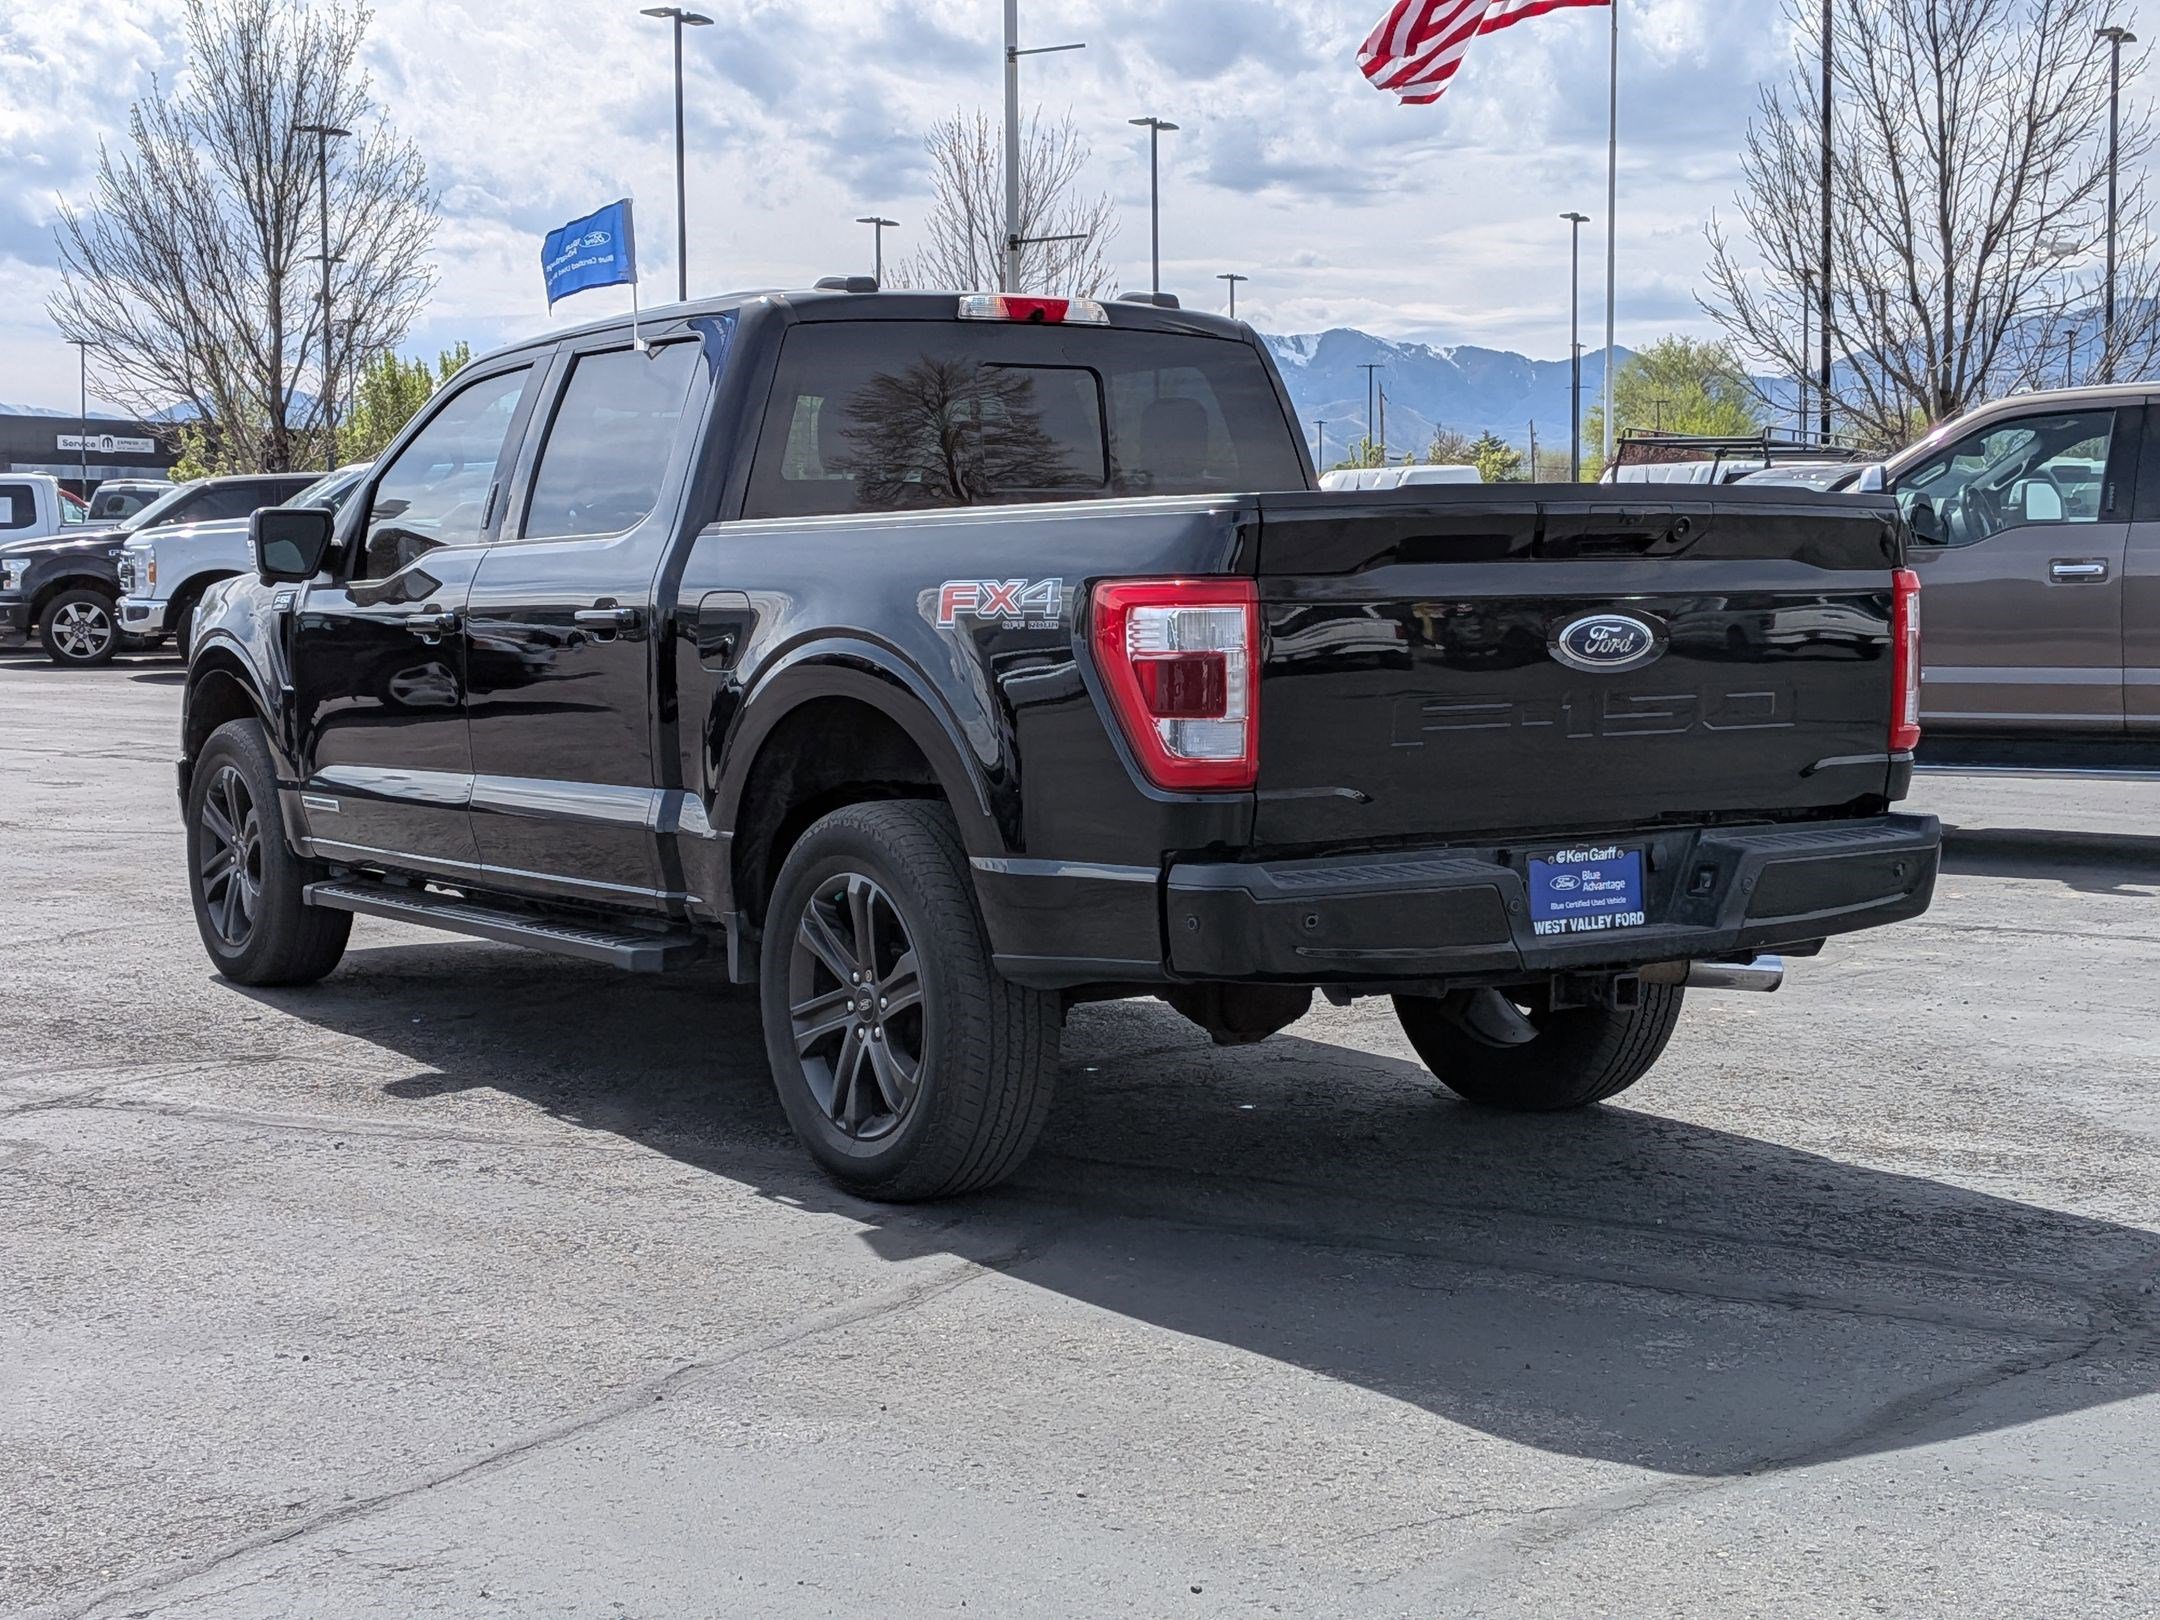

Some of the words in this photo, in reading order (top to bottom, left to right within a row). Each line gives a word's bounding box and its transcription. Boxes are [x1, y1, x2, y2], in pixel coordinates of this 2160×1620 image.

[62, 439, 96, 448] Servce
[936, 578, 1063, 629] FX4
[1584, 625, 1635, 654] Ford
[1390, 683, 1798, 747] F-150
[1566, 849, 1588, 863] Ken
[1589, 846, 1617, 861] Garff
[1556, 877, 1575, 888] Ford
[1582, 870, 1601, 880] Blue
[1582, 879, 1626, 892] Advantage
[1565, 899, 1590, 909] Certified
[1534, 919, 1567, 935] WEST
[1570, 914, 1613, 931] VALLEY
[1615, 911, 1645, 927] FORD
